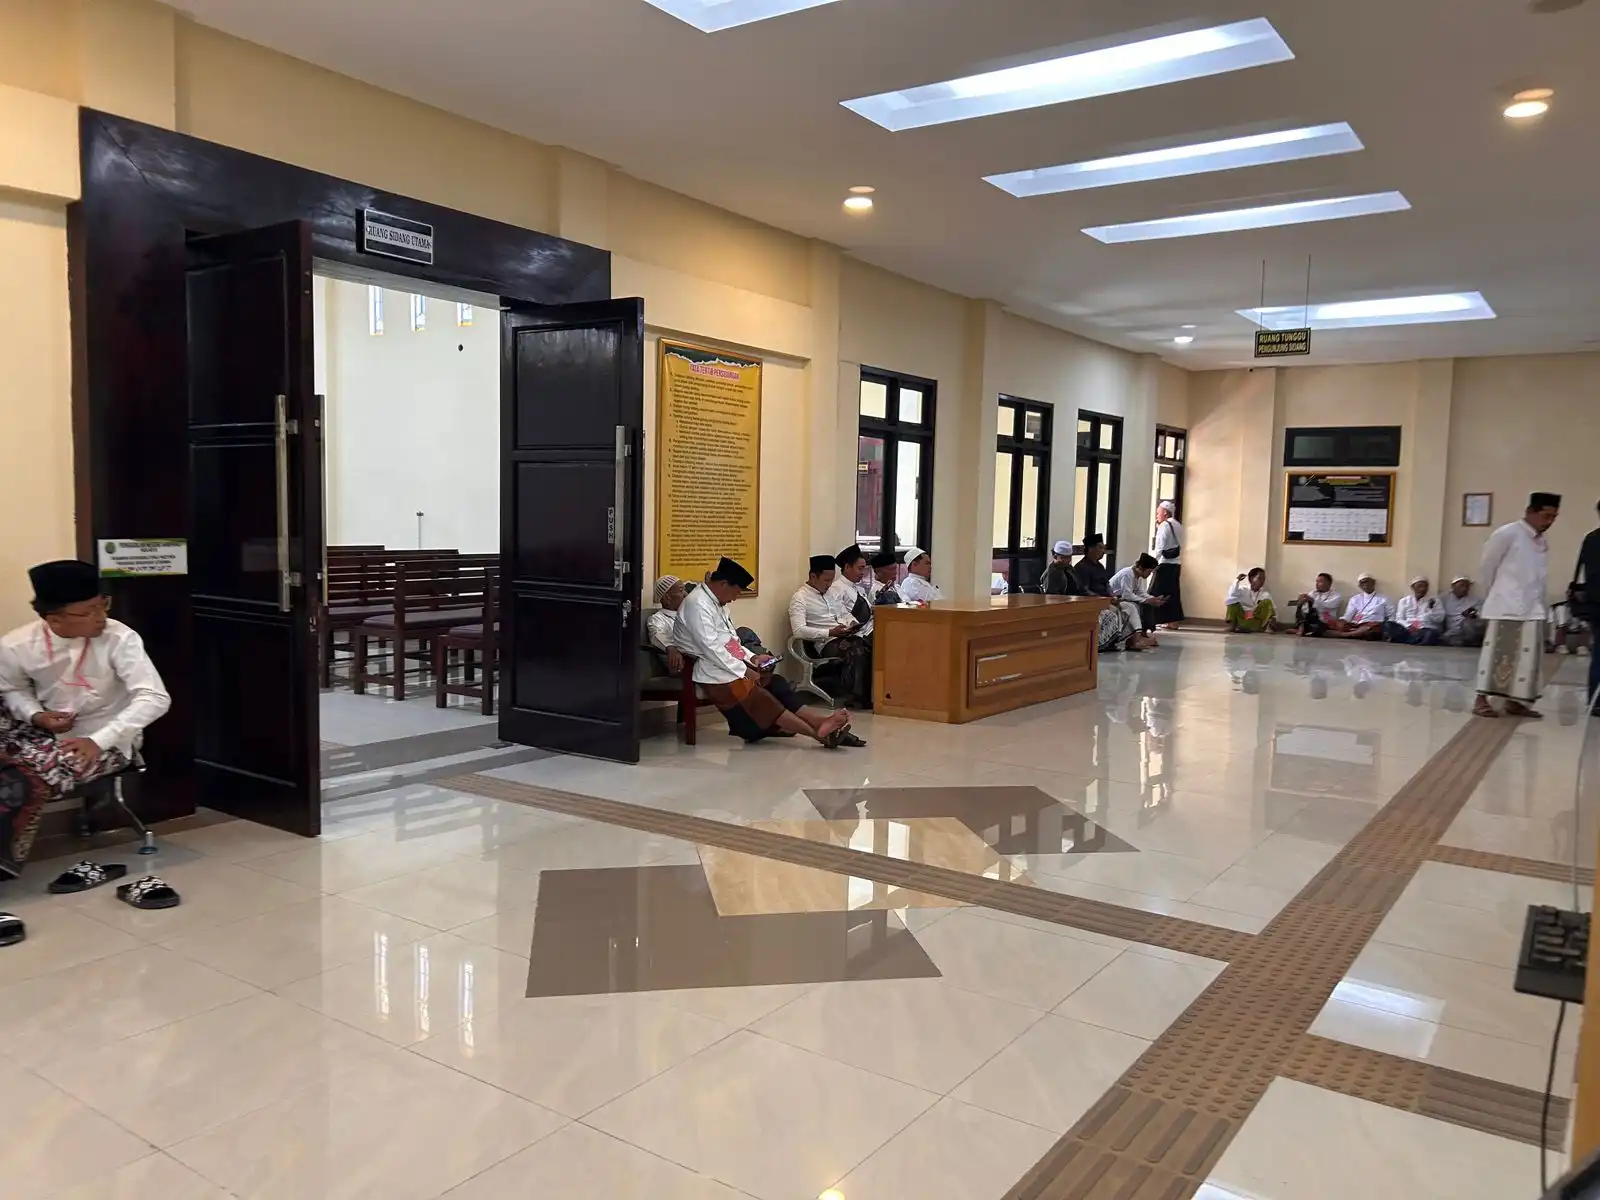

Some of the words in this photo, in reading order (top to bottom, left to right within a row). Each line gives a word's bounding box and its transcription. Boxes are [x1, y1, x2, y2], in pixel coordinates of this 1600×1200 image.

[389, 231, 411, 244] SIDANG
[411, 235, 430, 248] UTAMA
[1260, 333, 1280, 343] RUANG
[1281, 332, 1306, 341] TUNGGU
